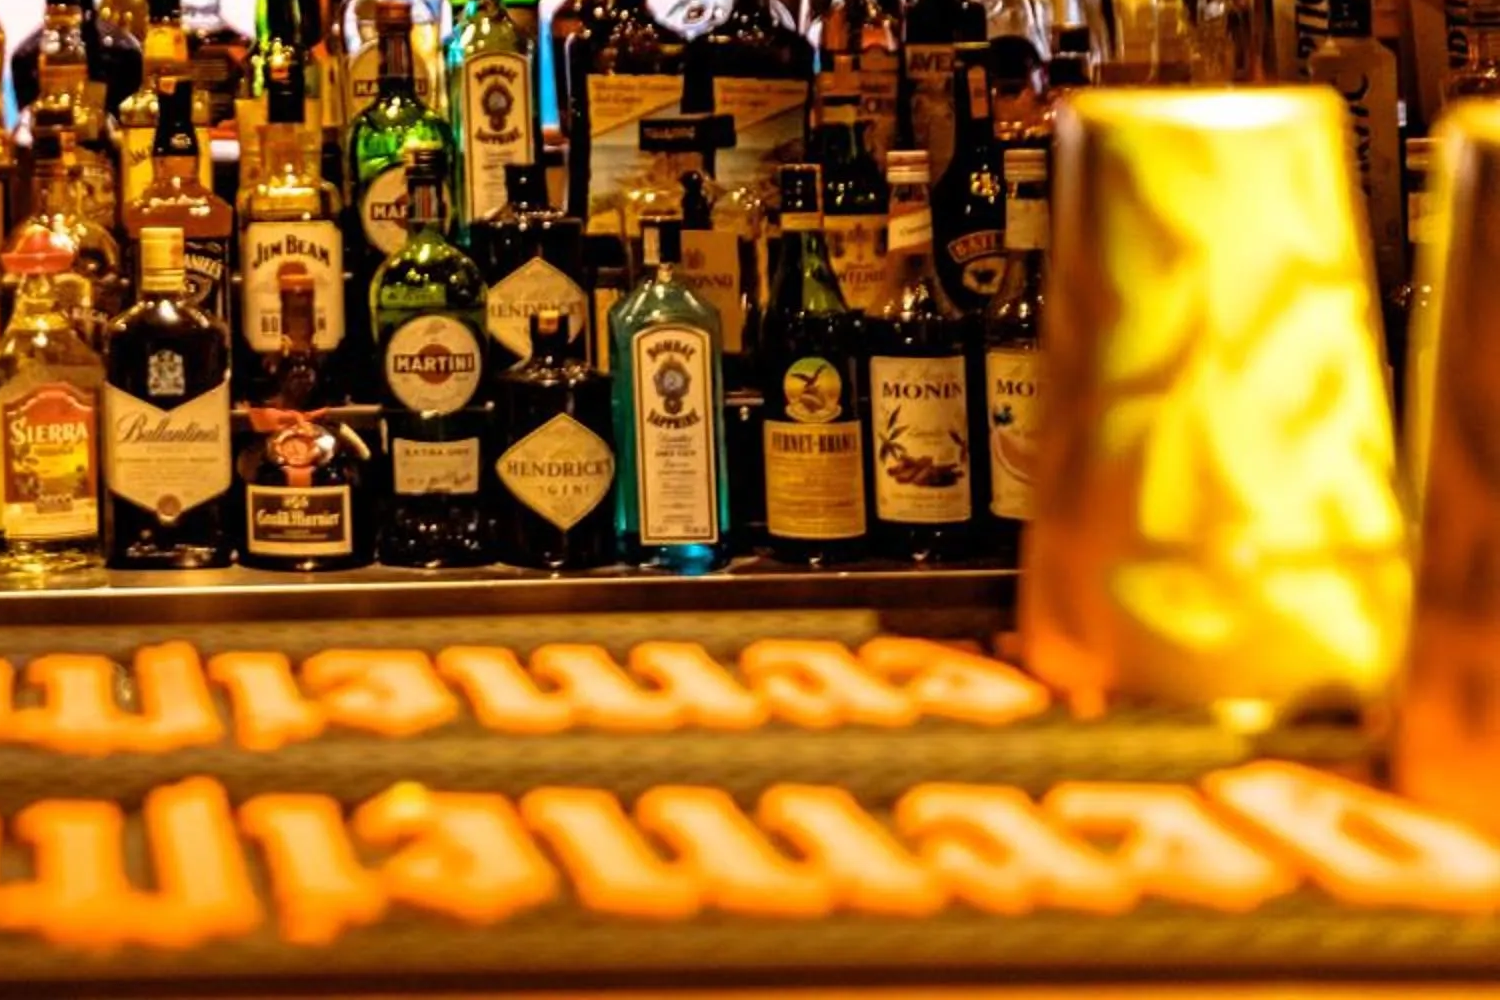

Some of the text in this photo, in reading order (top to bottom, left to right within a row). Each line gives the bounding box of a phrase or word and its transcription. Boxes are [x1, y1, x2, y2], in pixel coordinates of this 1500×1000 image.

[252, 234, 330, 269] JIM BEAM
[396, 354, 474, 373] MARTINI
[882, 380, 963, 400] MONIN
